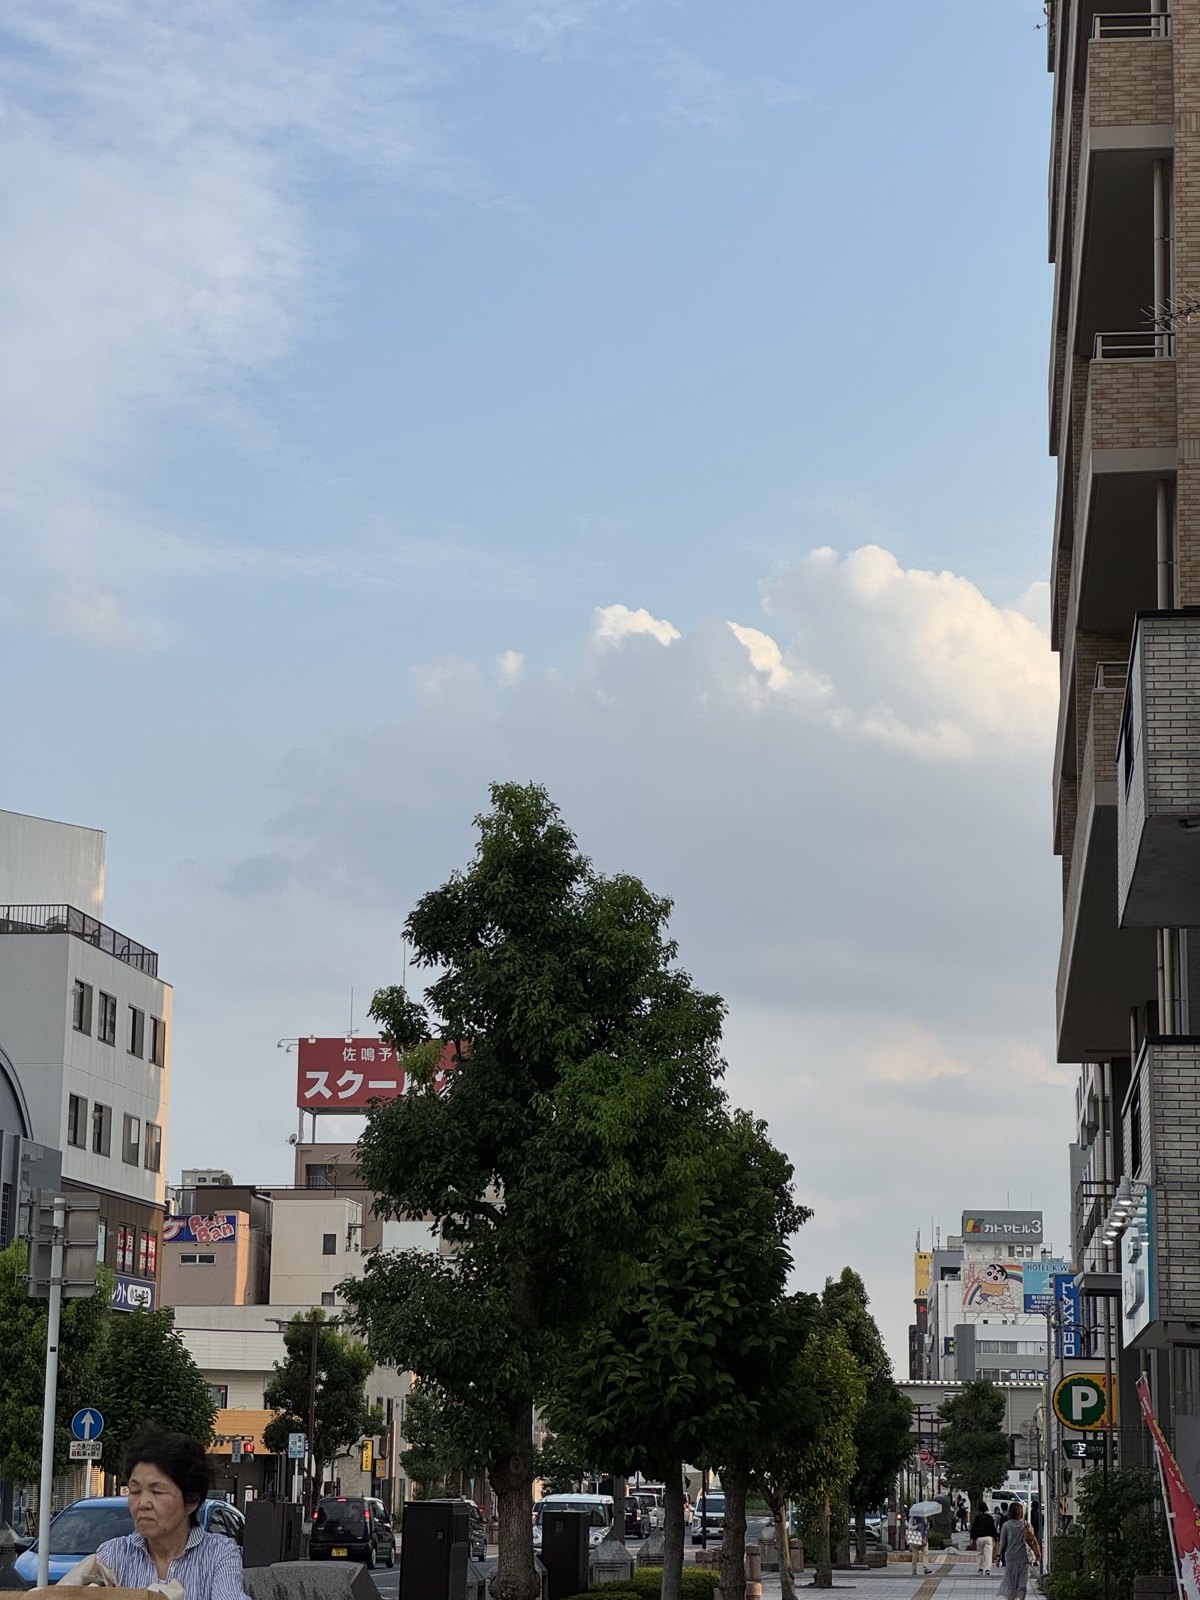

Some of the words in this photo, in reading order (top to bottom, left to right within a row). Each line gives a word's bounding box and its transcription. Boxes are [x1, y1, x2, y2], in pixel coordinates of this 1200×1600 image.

[189, 1215, 226, 1235] Ban
[196, 1223, 234, 1242] Ban
[1027, 1264, 1050, 1272] HOTEL
[1052, 1264, 1058, 1272] K
[1071, 1385, 1098, 1420] P
[1072, 1442, 1086, 1456] 空
